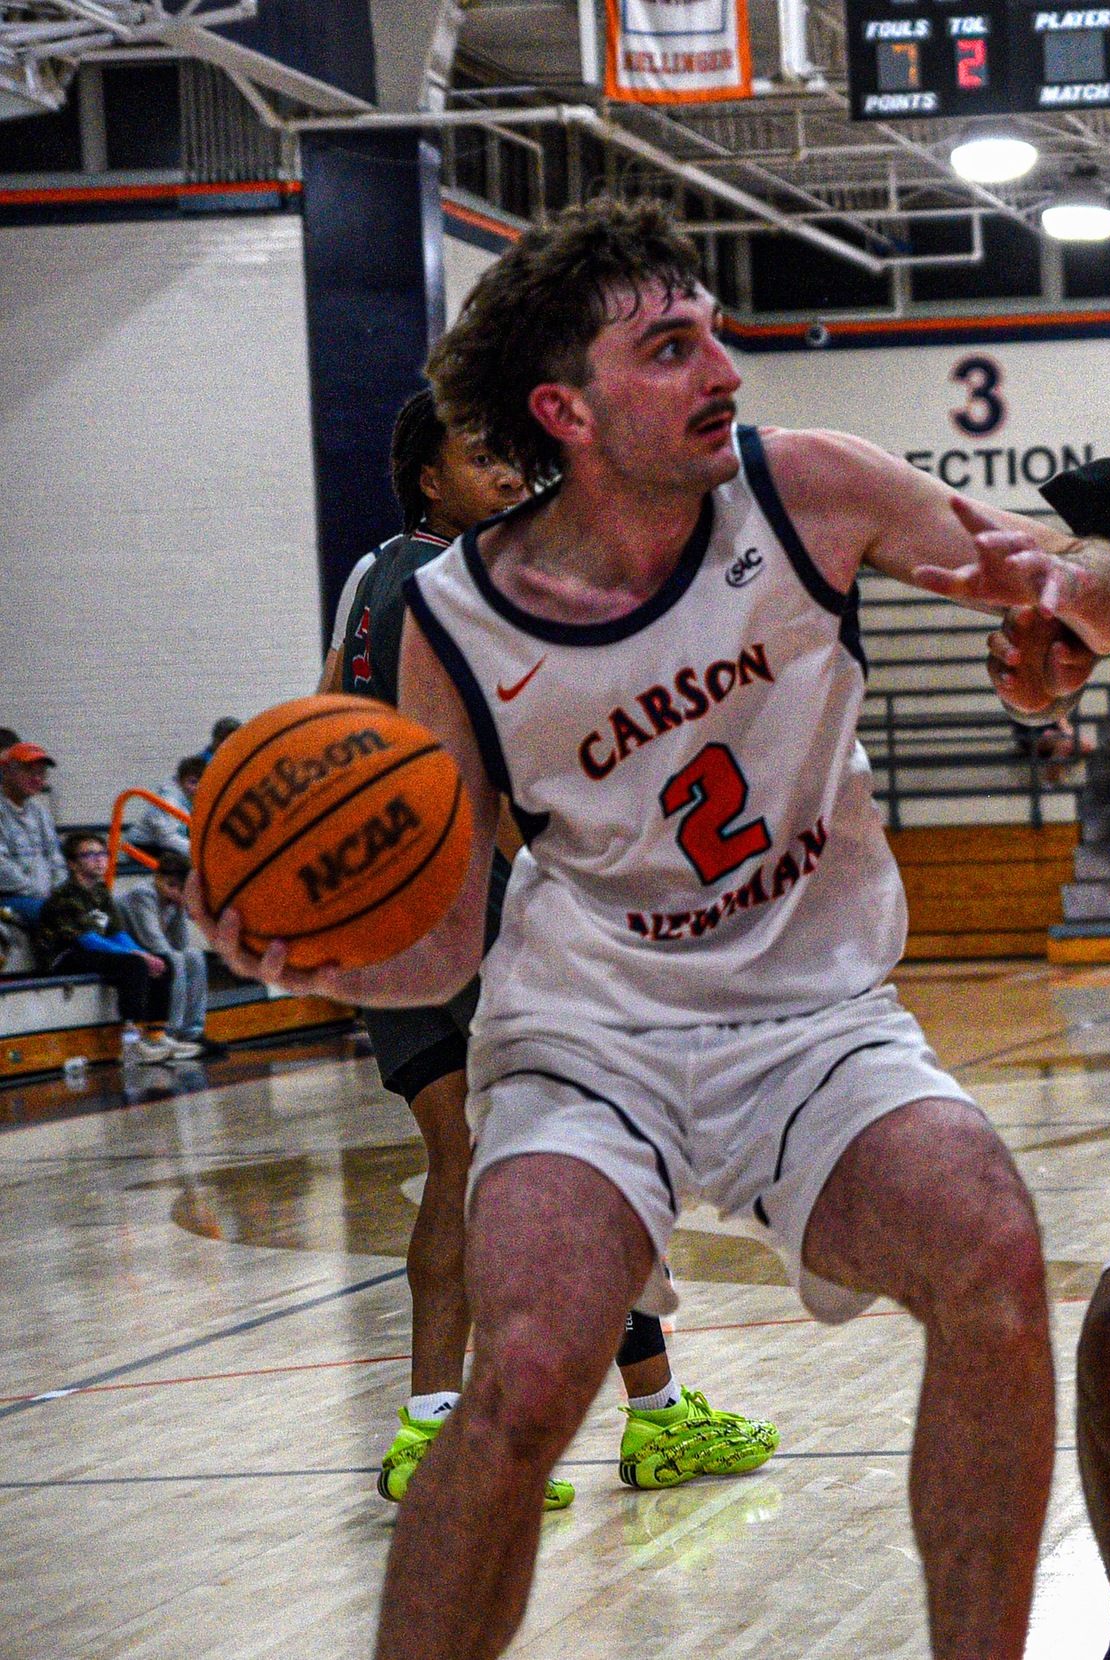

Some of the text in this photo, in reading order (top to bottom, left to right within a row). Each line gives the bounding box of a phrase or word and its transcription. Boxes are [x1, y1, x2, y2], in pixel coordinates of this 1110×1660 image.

[865, 18, 931, 40] FOULS
[949, 15, 989, 36] TOL
[956, 38, 988, 89] 2
[865, 91, 938, 114] POINTS
[950, 353, 1010, 439] 3
[577, 642, 776, 782] CARSON
[218, 726, 395, 851] Wilson
[659, 741, 773, 887] 2
[297, 794, 423, 903] NCAA
